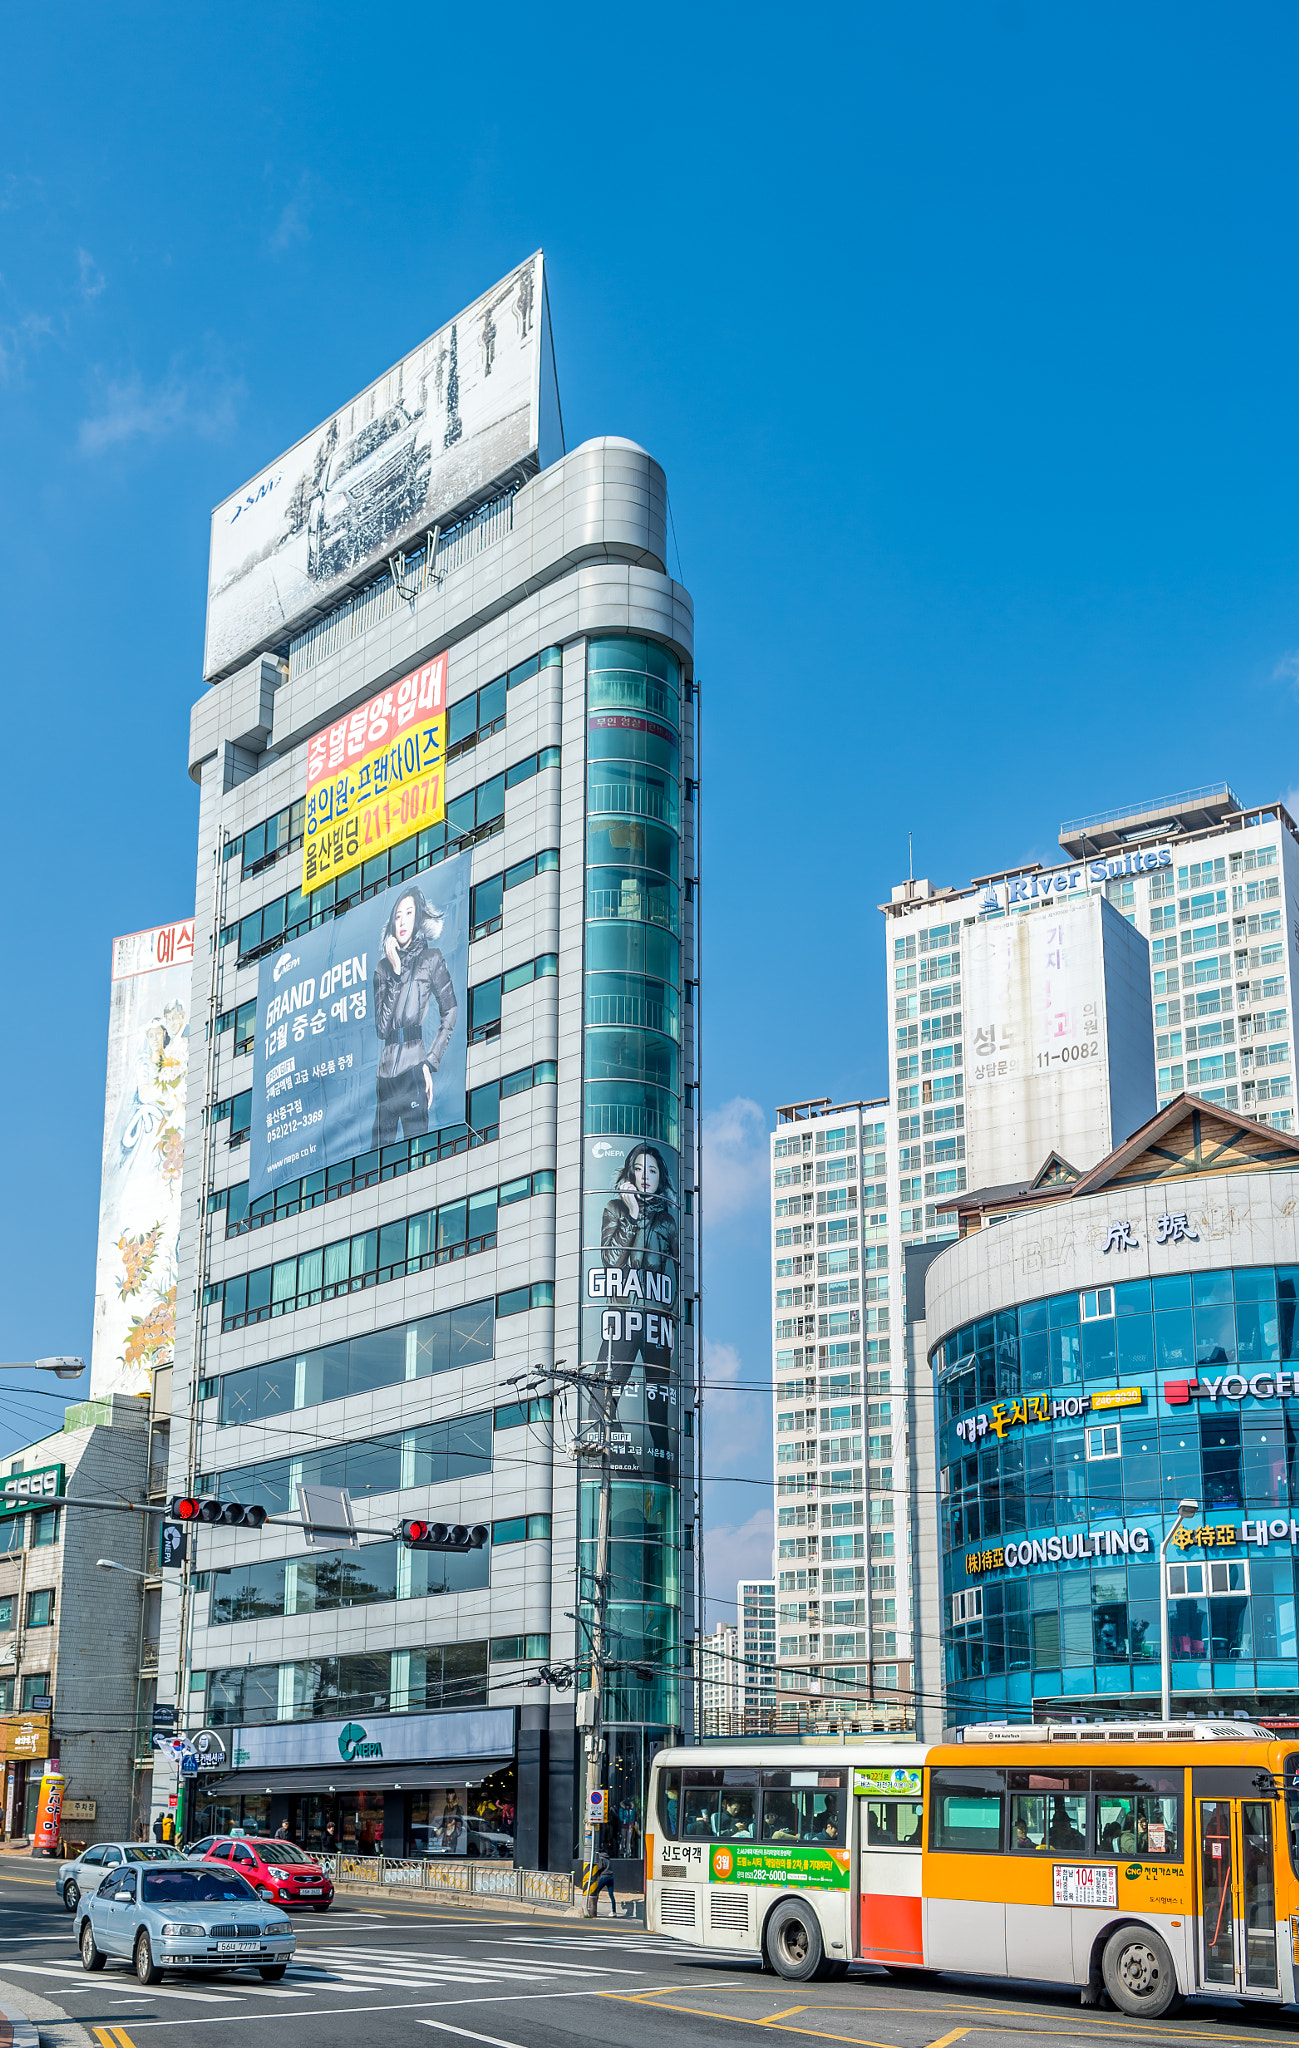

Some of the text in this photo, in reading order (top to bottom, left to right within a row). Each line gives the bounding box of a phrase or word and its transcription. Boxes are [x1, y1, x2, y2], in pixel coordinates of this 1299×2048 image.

[306, 774, 440, 880] 울산빌딩 211-0077
[1008, 848, 1171, 903] River Suites
[266, 953, 368, 1031] GRAND OPEN
[265, 989, 367, 1060] 12월 중순 예정
[294, 1069, 309, 1085] 고급
[312, 1060, 336, 1078] 사은품
[337, 1053, 353, 1071] 증정
[266, 1098, 303, 1128] 울산중구점
[267, 1109, 323, 1143] 052)212-3369
[588, 1268, 672, 1305] GRAND
[602, 1310, 674, 1349] OPEN
[1201, 1371, 1299, 1402] YOGE
[956, 1413, 989, 1442] 이경규
[989, 1393, 1050, 1438] 돈치킨
[1053, 1395, 1090, 1418] HOF
[612, 1433, 629, 1441] GIFT
[628, 1446, 643, 1456] 고급
[164, 1540, 172, 1564] NEPA
[1004, 1527, 1150, 1568] CONSULTING
[355, 1742, 382, 1757] NEPA
[74, 1802, 95, 1812] 주차장
[661, 1845, 702, 1864] 신도여객
[716, 1855, 730, 1870] 3월
[753, 1869, 787, 1881] 282-6000
[1076, 1868, 1094, 1886] 104
[1126, 1868, 1142, 1876] CNG
[1144, 1866, 1185, 1881] 천연가스버스
[1149, 1896, 1178, 1905] 도시형버스
[238, 1942, 257, 1950] 7777
